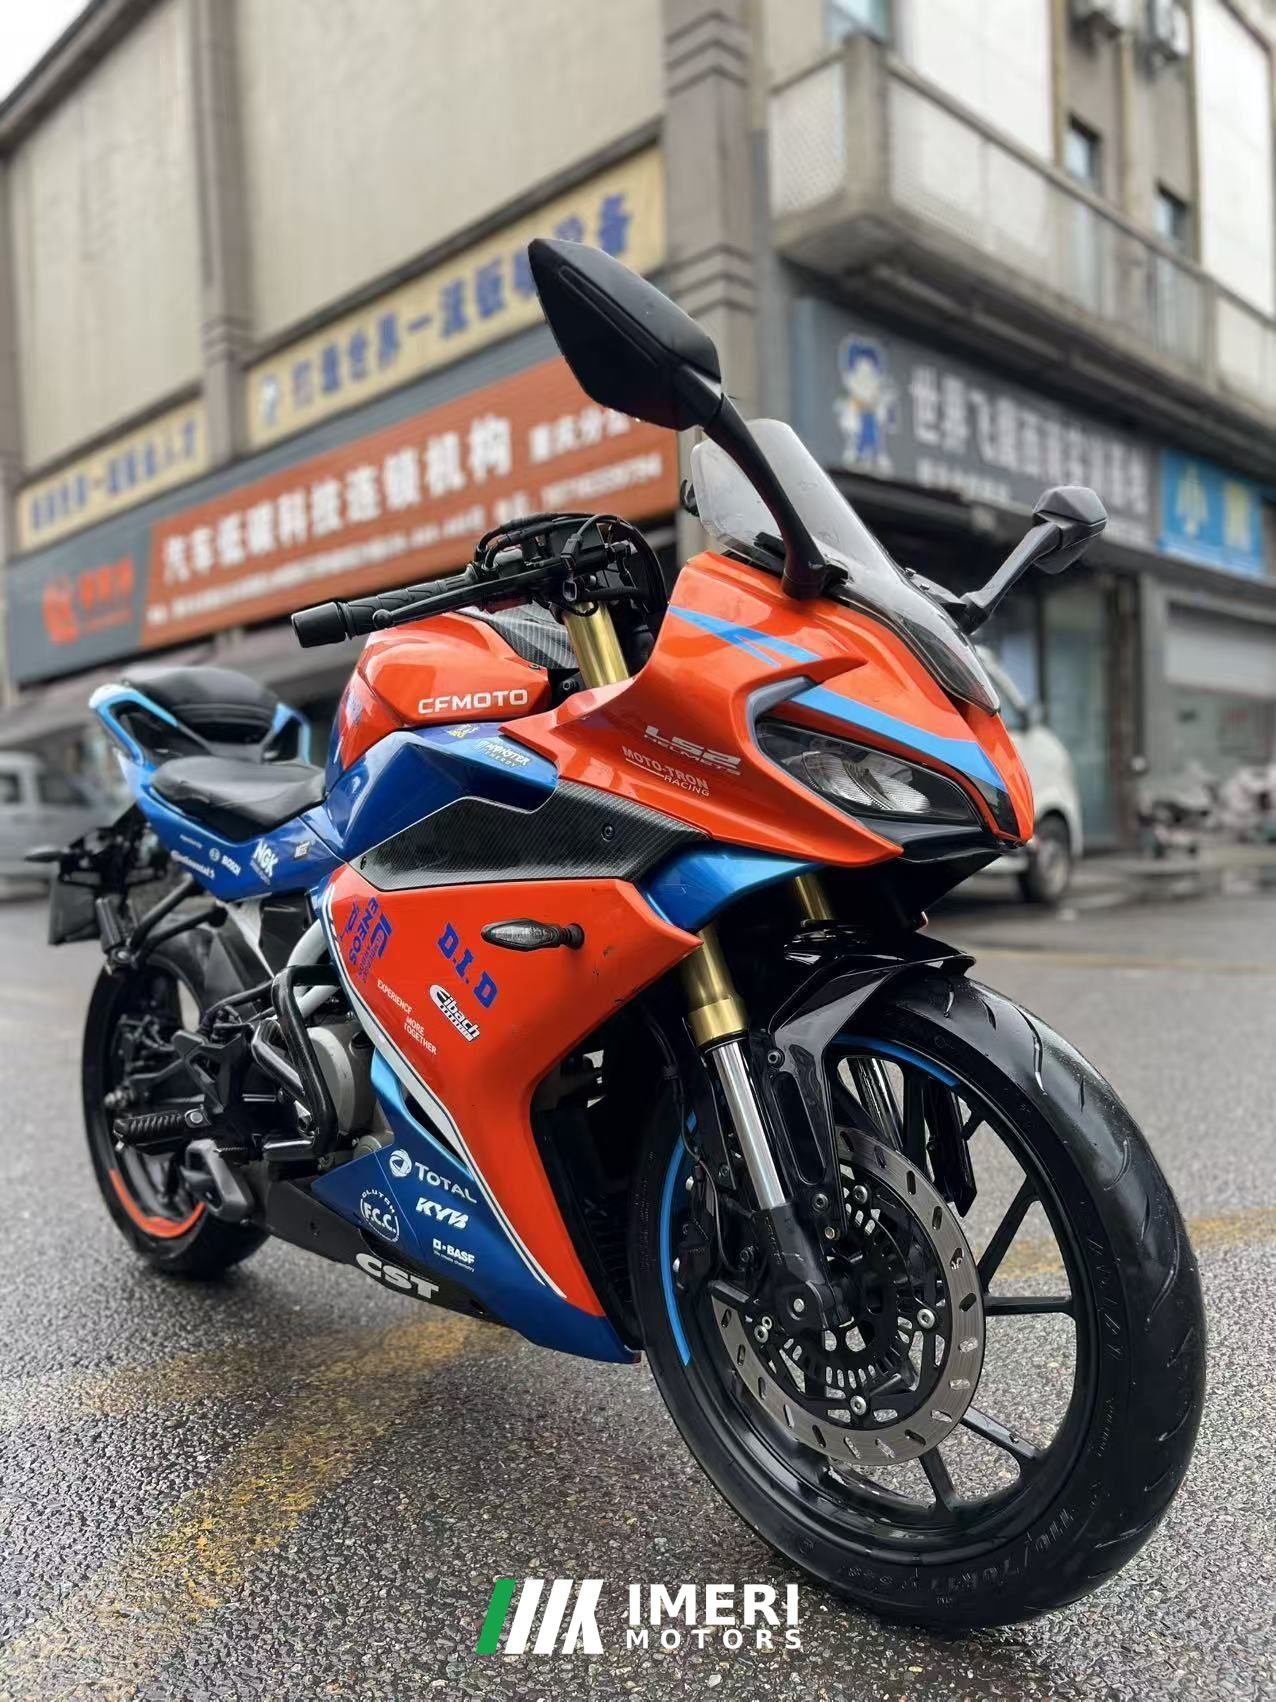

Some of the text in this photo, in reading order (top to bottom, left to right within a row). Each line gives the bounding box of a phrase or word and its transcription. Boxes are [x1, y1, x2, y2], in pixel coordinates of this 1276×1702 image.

[418, 689, 528, 714] CFMOTO
[645, 725, 741, 769] LS2
[622, 745, 709, 790] MOTO-TRON
[664, 774, 710, 797] RACING
[252, 838, 279, 878] NGK
[348, 896, 379, 966] ENEOS
[377, 979, 413, 1014] EXPERIENCE
[403, 1022, 438, 1056] TOGETHER
[405, 1015, 426, 1037] MORE
[414, 1161, 478, 1204] TOTAL
[415, 1196, 469, 1229] KYB
[446, 1243, 476, 1264] BASF
[355, 1252, 439, 1299] CST
